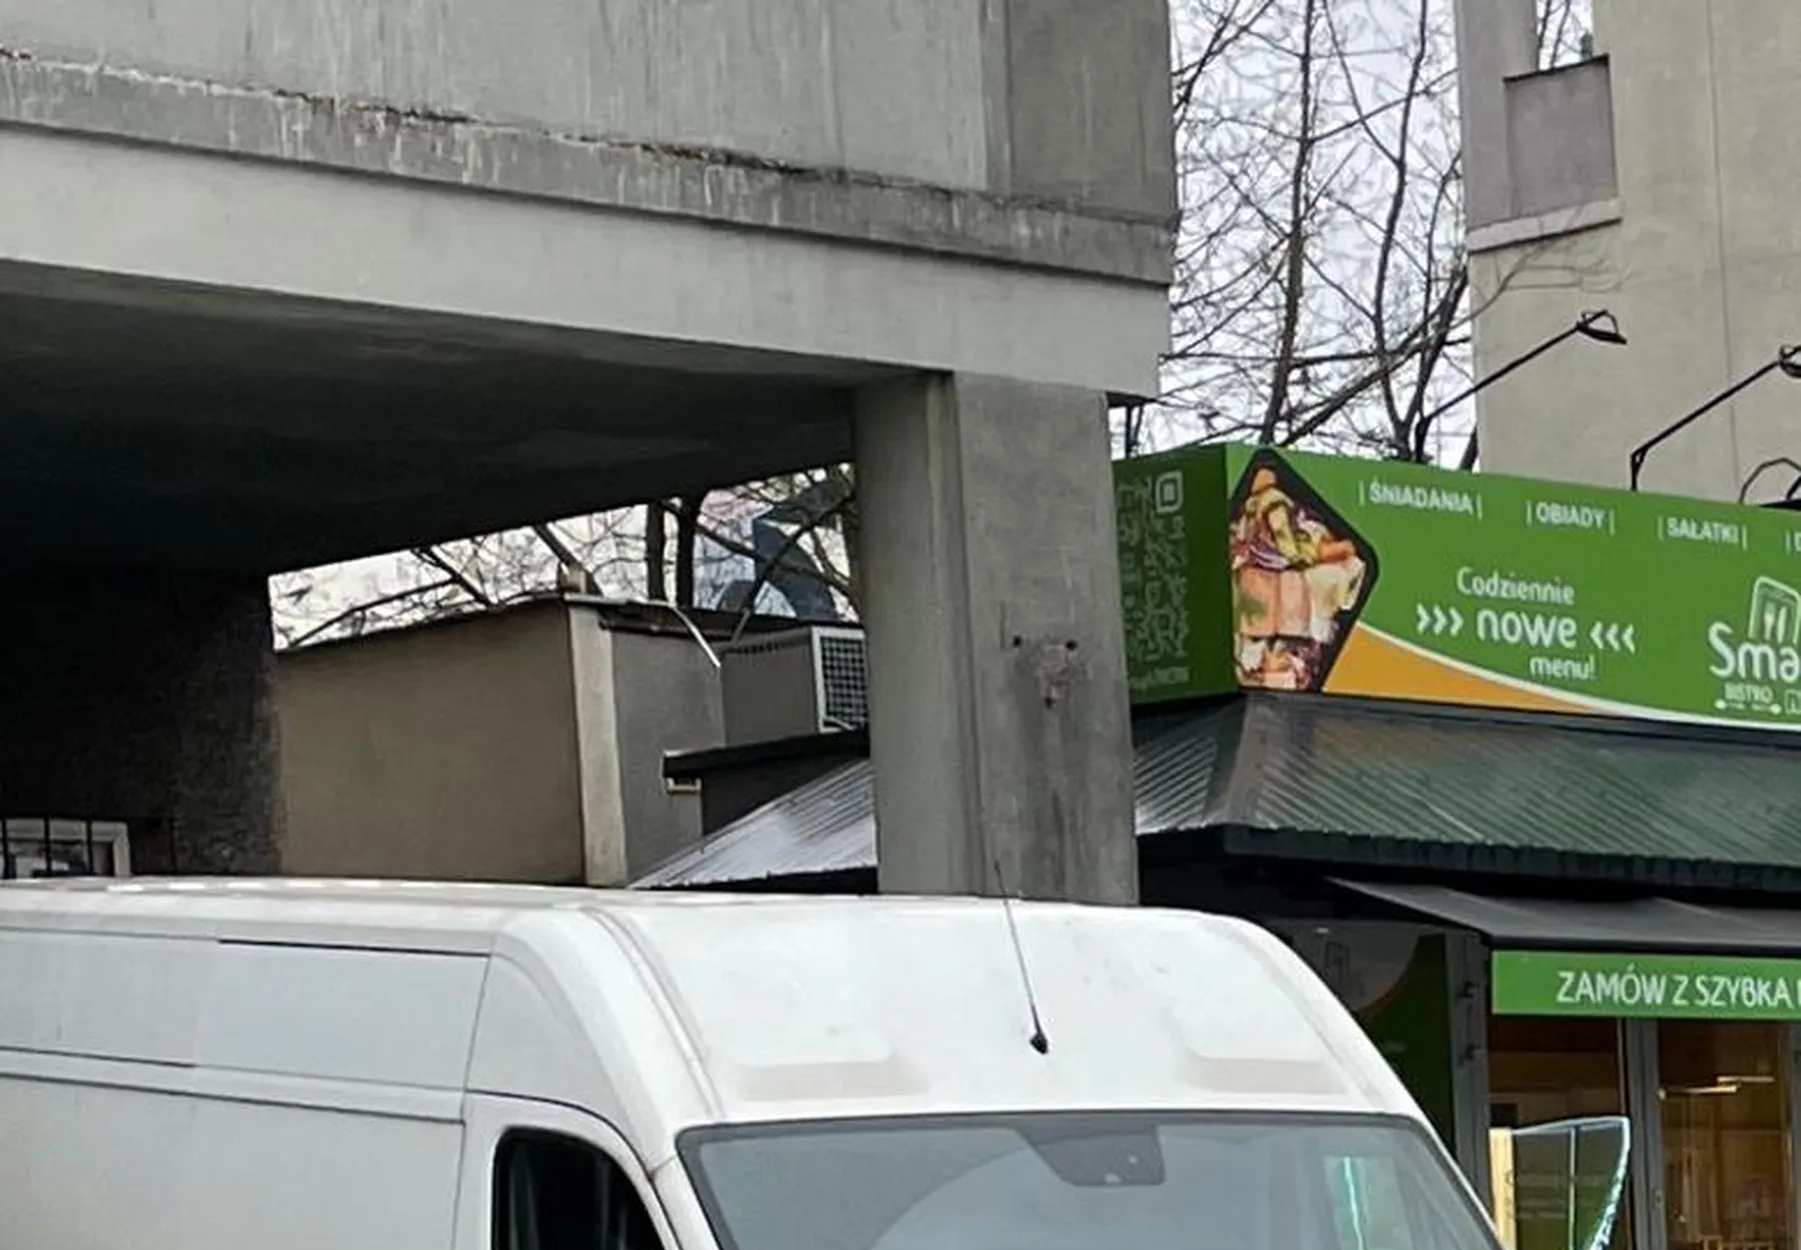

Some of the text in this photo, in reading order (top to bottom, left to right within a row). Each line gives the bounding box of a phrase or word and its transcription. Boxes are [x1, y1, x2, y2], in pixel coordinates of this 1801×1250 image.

[1369, 475, 1474, 515] ŚNIADANIA
[1536, 501, 1606, 529] OBIADY
[1456, 566, 1575, 605] Codziennie
[1477, 608, 1577, 649] nowe
[1529, 653, 1596, 681] menu!
[1556, 963, 1667, 1005] ZAMÓW
[1671, 974, 1690, 1006] Z
[1695, 975, 1795, 1009] SZYBKA
